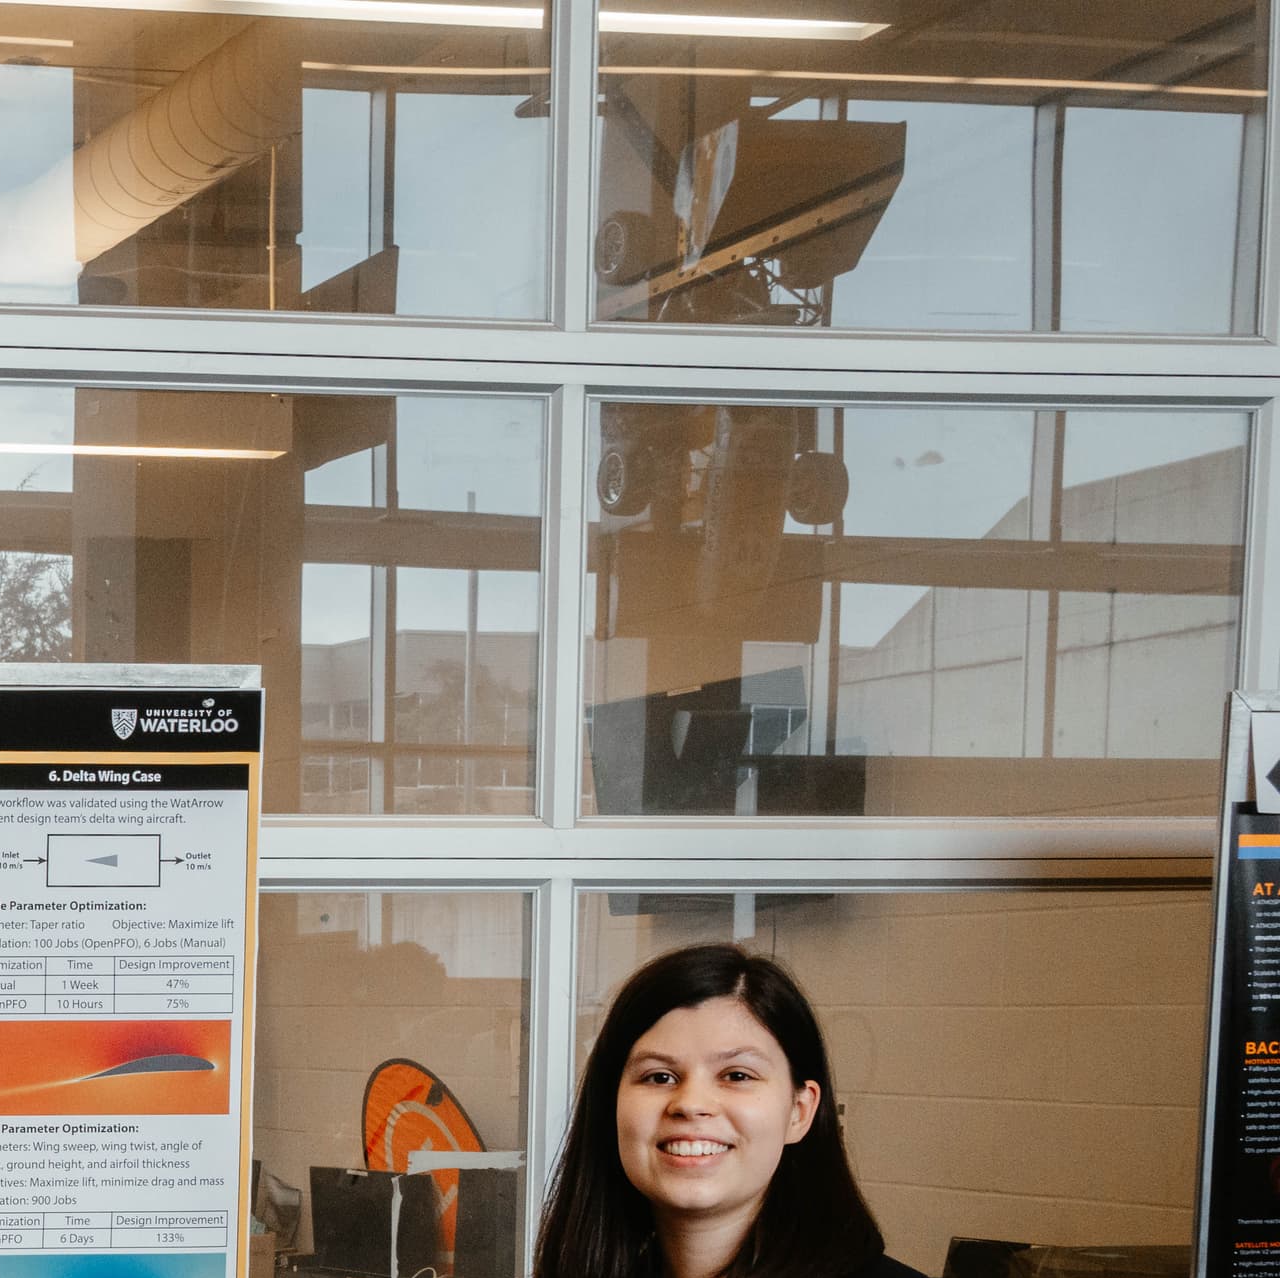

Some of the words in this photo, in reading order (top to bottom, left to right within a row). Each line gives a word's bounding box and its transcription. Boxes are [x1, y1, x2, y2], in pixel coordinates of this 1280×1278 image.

[146, 709, 213, 717] UNIVERSITY
[218, 709, 233, 717] OF
[140, 718, 239, 733] WATERLOO
[48, 770, 61, 782] 6.
[62, 769, 97, 782] Delta
[97, 769, 131, 785] Wing
[131, 770, 162, 783] Case
[1252, 882, 1275, 896] AT
[1245, 1041, 1280, 1055] BAC
